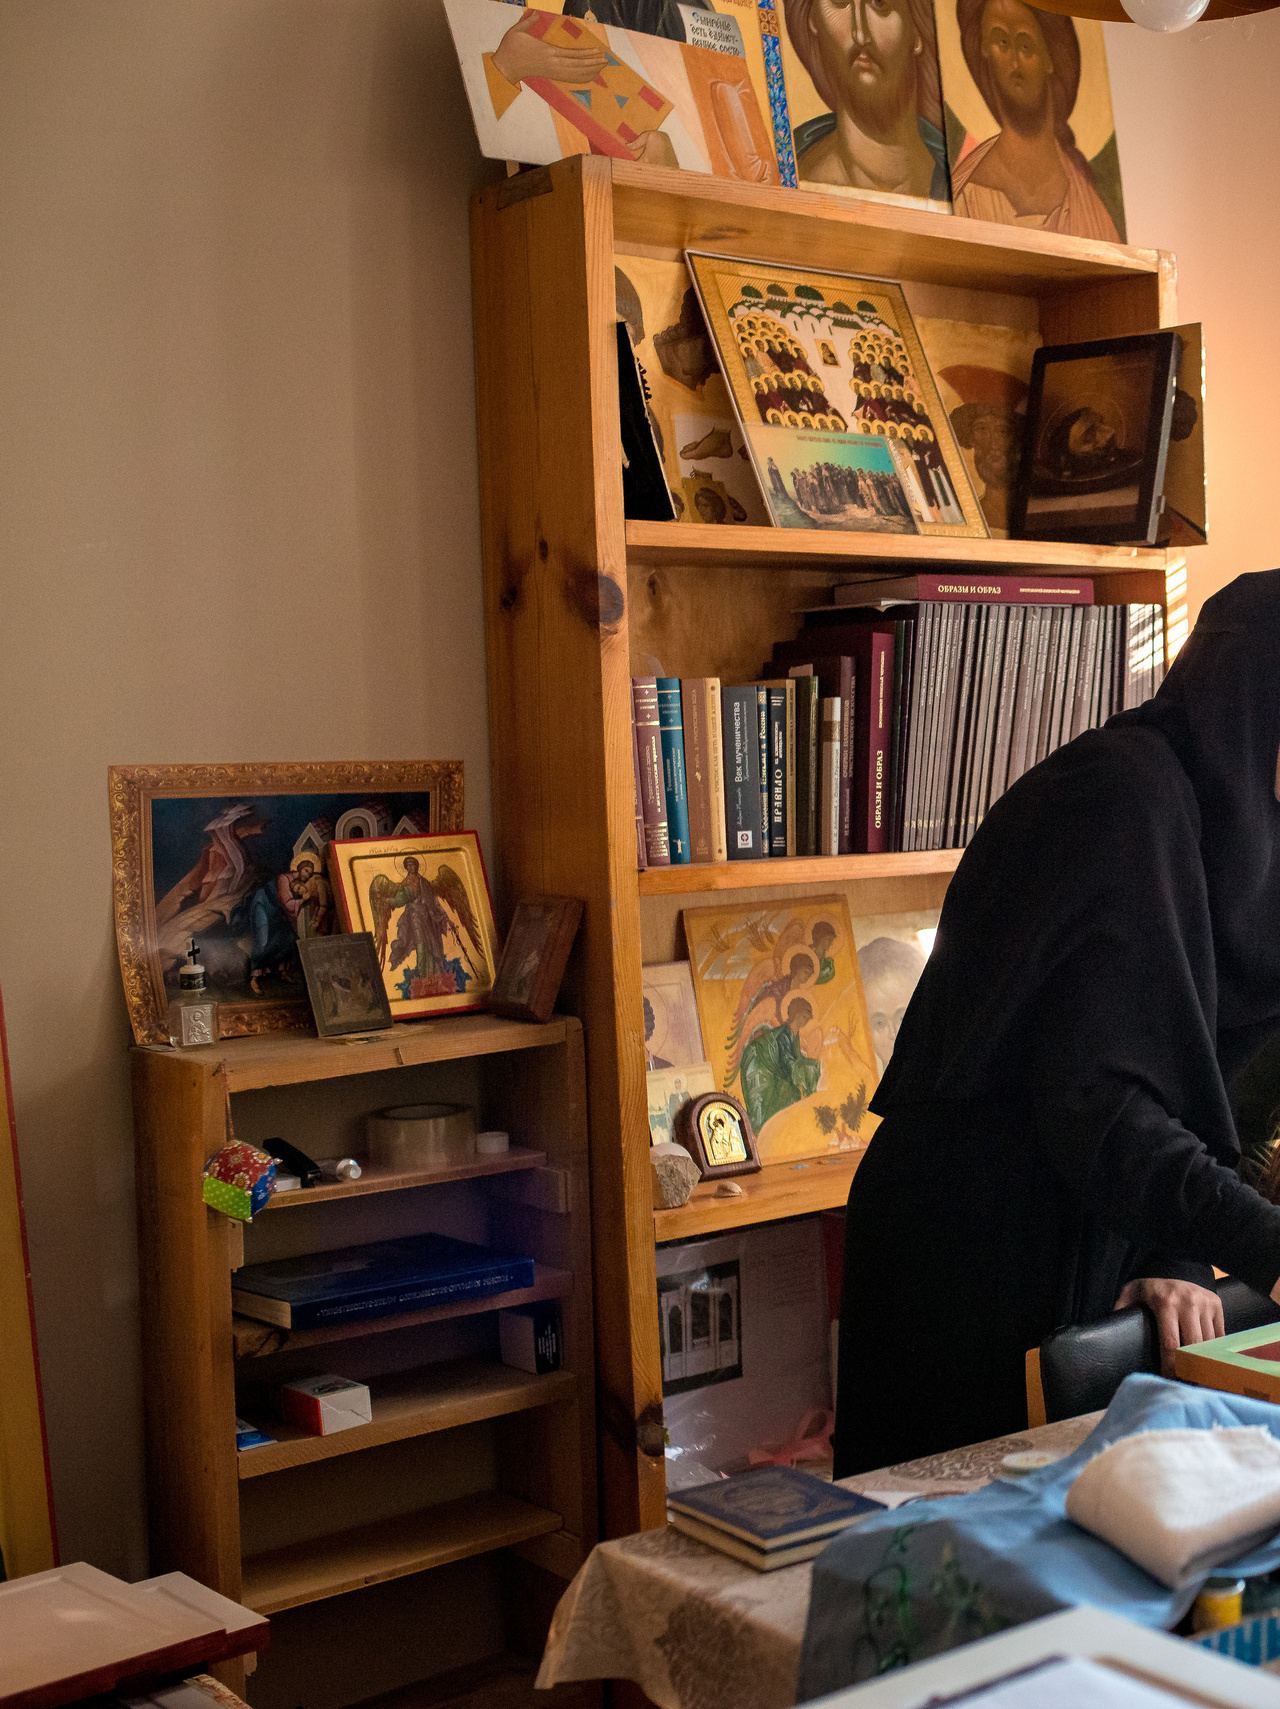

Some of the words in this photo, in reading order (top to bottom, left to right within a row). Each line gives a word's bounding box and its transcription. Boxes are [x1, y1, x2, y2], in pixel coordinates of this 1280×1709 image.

[937, 585, 968, 593] ОБРАЗЫ
[977, 586, 1001, 594] ОБРАЗ
[733, 701, 744, 763] мученичества
[734, 765, 742, 782] Век
[773, 768, 782, 822] ПРАВИЛО
[874, 791, 882, 828] ОБРАЗЫ
